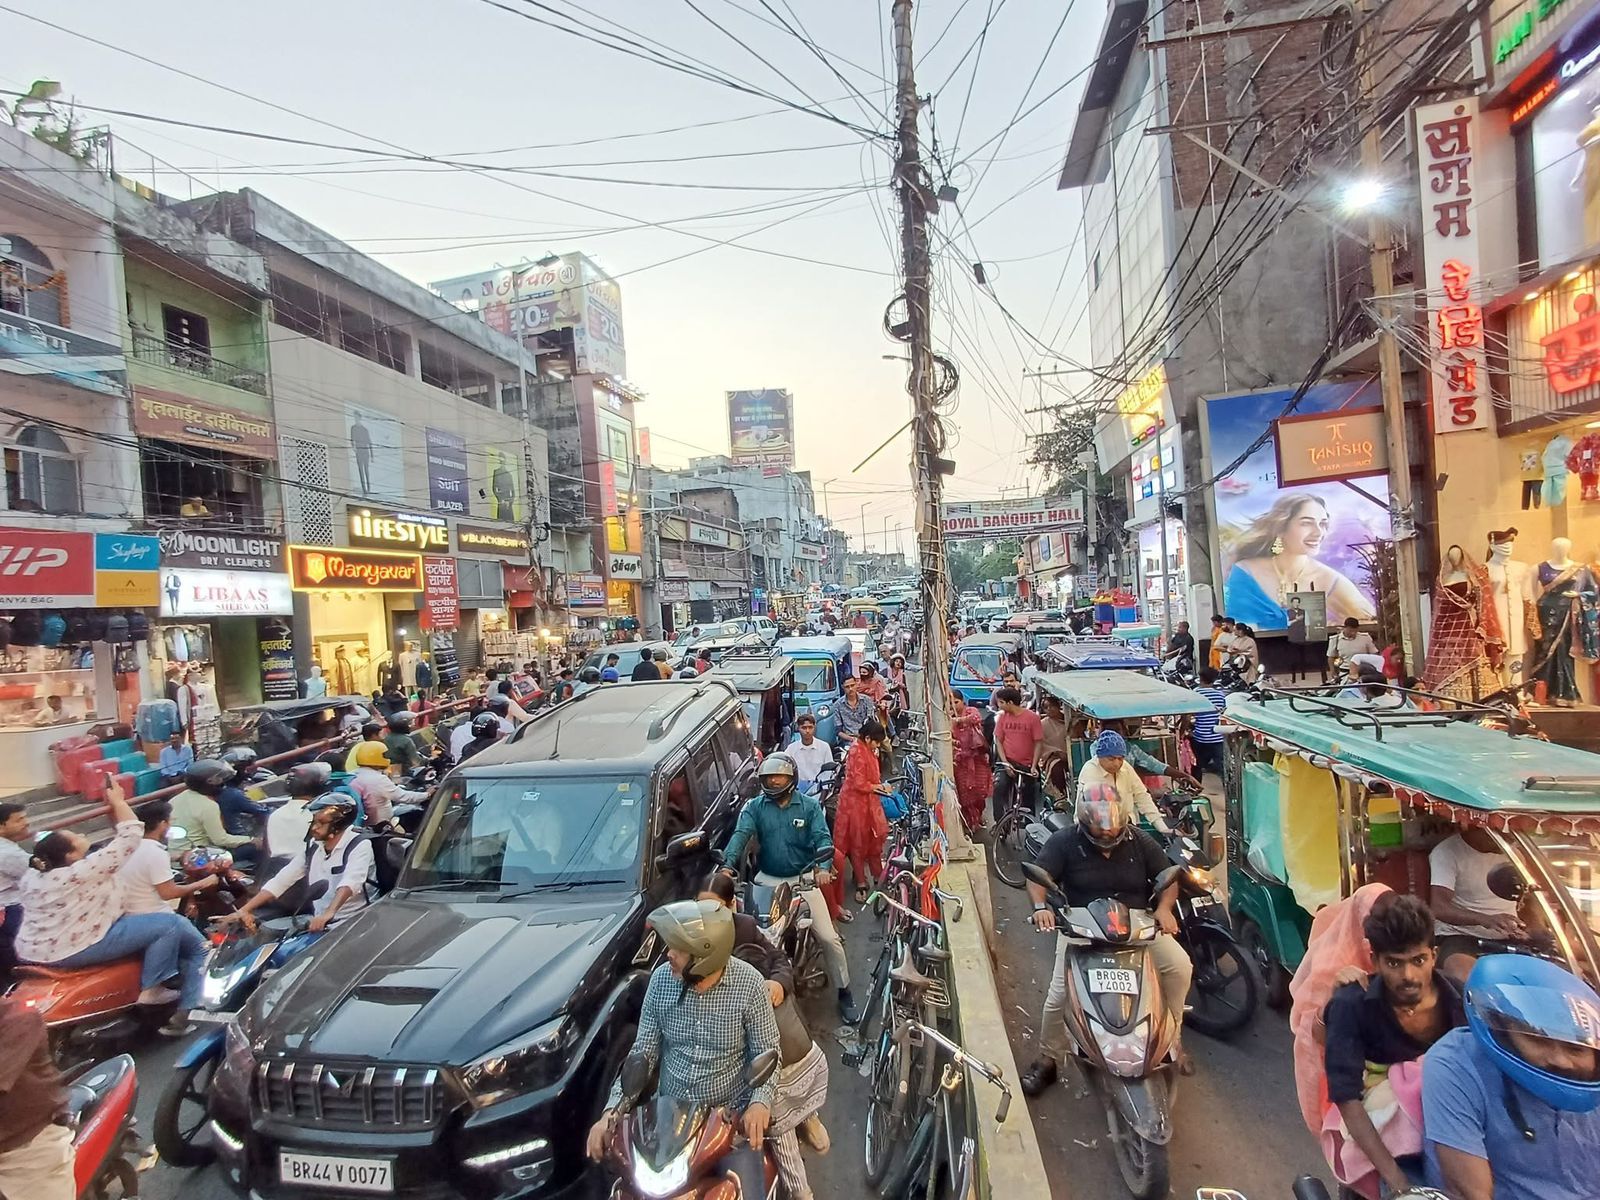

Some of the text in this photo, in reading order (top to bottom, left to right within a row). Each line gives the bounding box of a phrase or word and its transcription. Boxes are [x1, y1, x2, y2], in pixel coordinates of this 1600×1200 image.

[437, 500, 464, 512] BLAZER
[941, 508, 1082, 531] ROYAL BANQUET HALL
[180, 535, 281, 556] MOONLIGHT
[201, 556, 271, 568] DRY CLEANERS
[327, 556, 416, 585] Manyavar
[30, 596, 55, 604] BAG
[193, 586, 269, 602] LIBAAS
[1096, 970, 1130, 981] BR06B
[292, 1161, 388, 1185] BR44 V 0077
